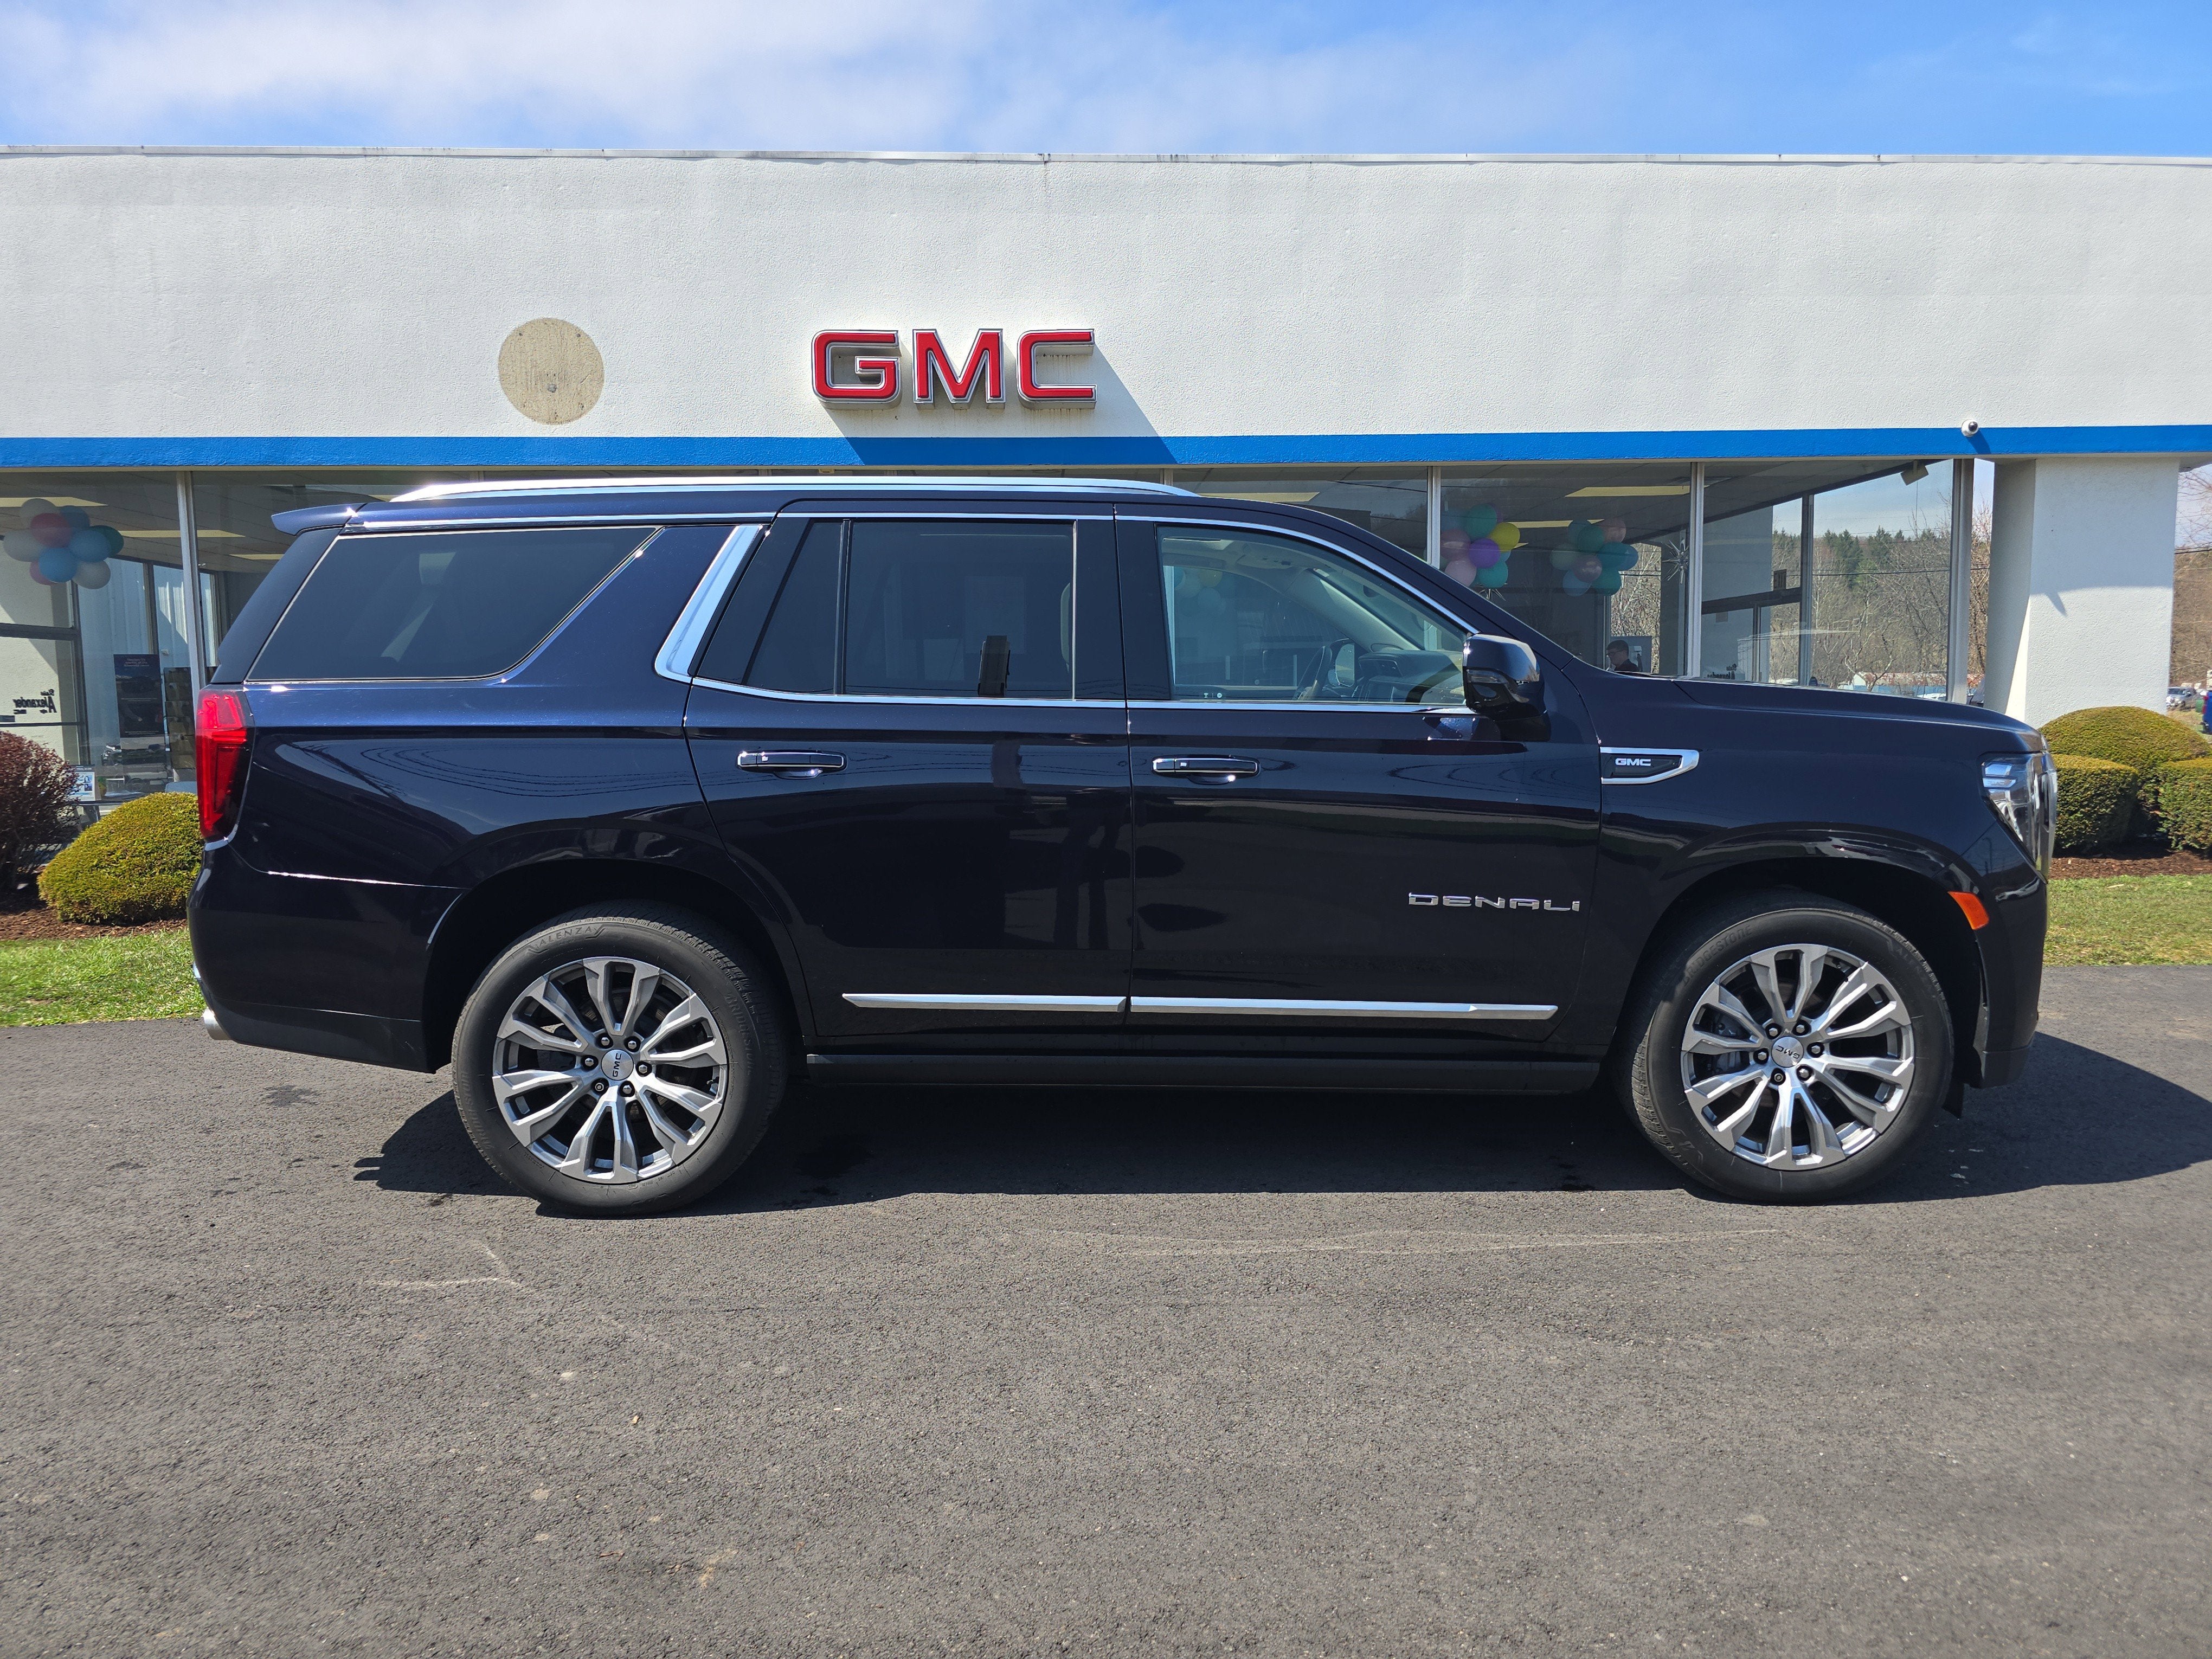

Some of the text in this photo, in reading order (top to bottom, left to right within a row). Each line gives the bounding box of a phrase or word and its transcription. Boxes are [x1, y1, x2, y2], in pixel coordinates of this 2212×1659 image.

[812, 329, 1096, 406] GMC
[1615, 757, 1651, 767] GMC
[1409, 892, 1580, 912] DENALI
[1776, 1045, 1800, 1059] GMC
[613, 1053, 622, 1077] GMC
